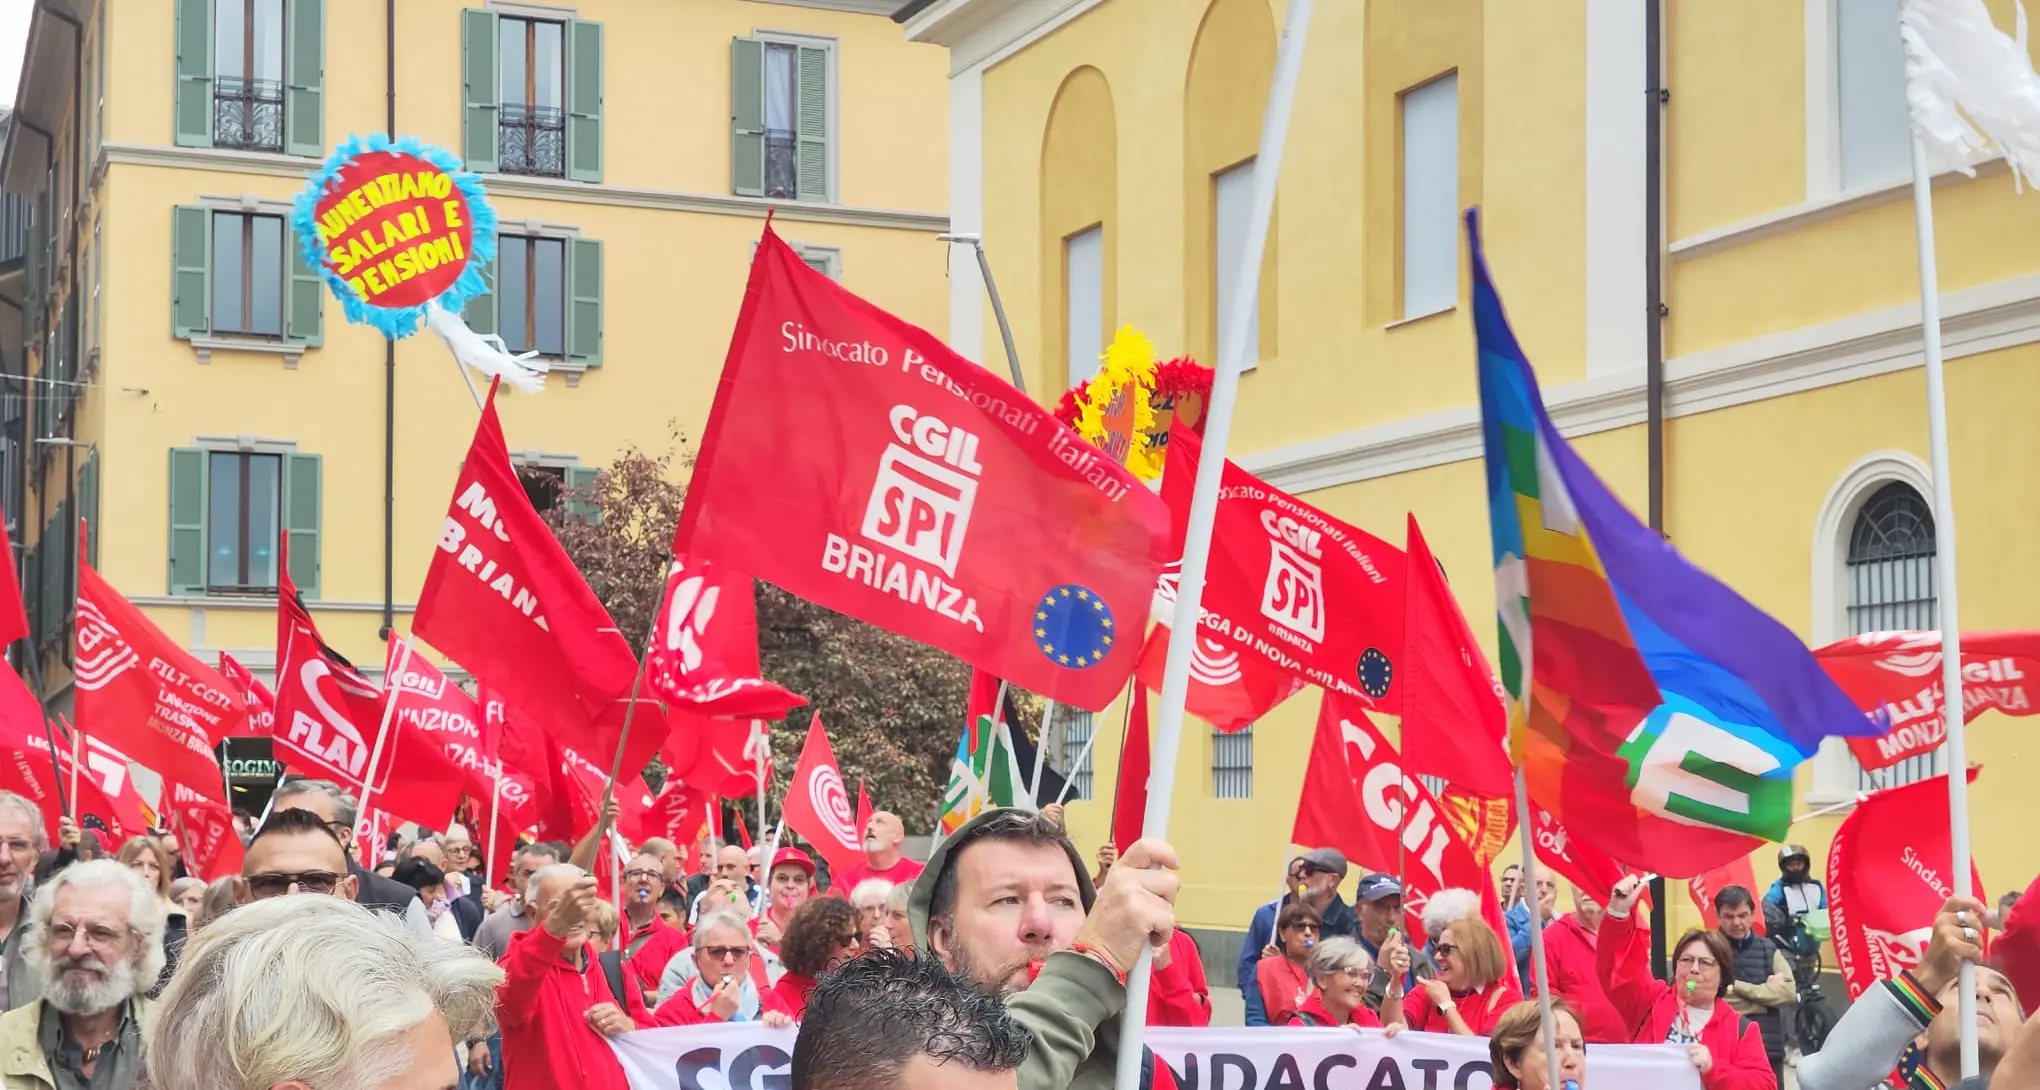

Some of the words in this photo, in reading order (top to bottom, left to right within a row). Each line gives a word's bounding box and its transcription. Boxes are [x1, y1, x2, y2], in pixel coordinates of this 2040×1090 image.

[330, 205, 431, 275] SALARI
[443, 200, 463, 228] E
[347, 231, 465, 302] PENSIONI
[889, 404, 983, 476] CGIL
[902, 348, 1043, 436] Pensionati
[1047, 427, 1132, 503] Italiani
[876, 486, 956, 562] SPI
[1260, 508, 1323, 561] CGIL
[1267, 492, 1346, 542] Pensionati
[1342, 540, 1388, 585] Italiani
[821, 533, 984, 633] BRIANZA
[1271, 567, 1318, 632] SPI
[1197, 606, 1231, 636] EGA
[1233, 626, 1251, 646] DI
[1254, 638, 1302, 672] NOVA
[148, 656, 232, 712] FILT-CGIL
[288, 710, 368, 778] FLAI
[1829, 835, 1844, 883] LEGA
[1830, 884, 1842, 906] DI
[1832, 908, 1856, 981] MONZA
